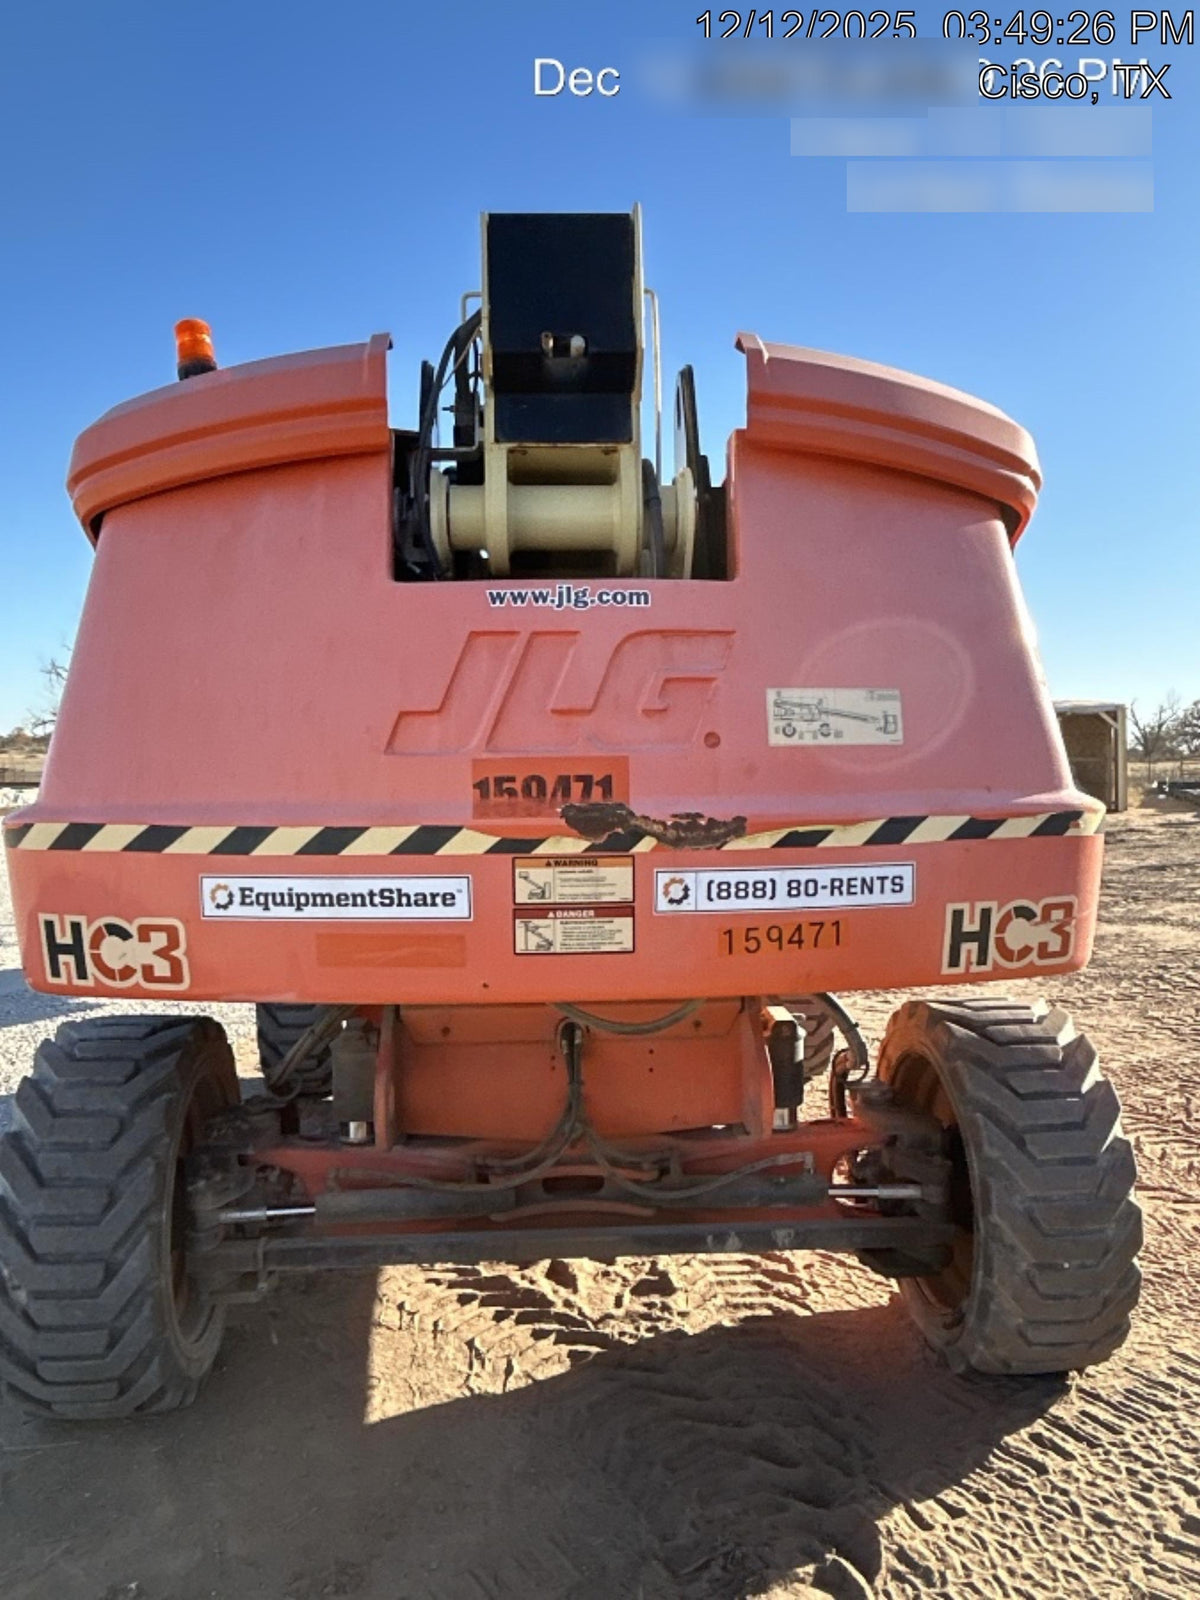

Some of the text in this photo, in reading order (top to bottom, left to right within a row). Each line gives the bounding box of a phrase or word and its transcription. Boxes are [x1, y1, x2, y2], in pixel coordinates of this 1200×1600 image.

[487, 584, 651, 610] www.jlg.com
[384, 630, 737, 756] JLG
[238, 886, 457, 912] EquipmentShare
[706, 874, 905, 901] (888) 80-RENTS
[555, 909, 596, 918] DANGER
[721, 919, 844, 956] 159471
